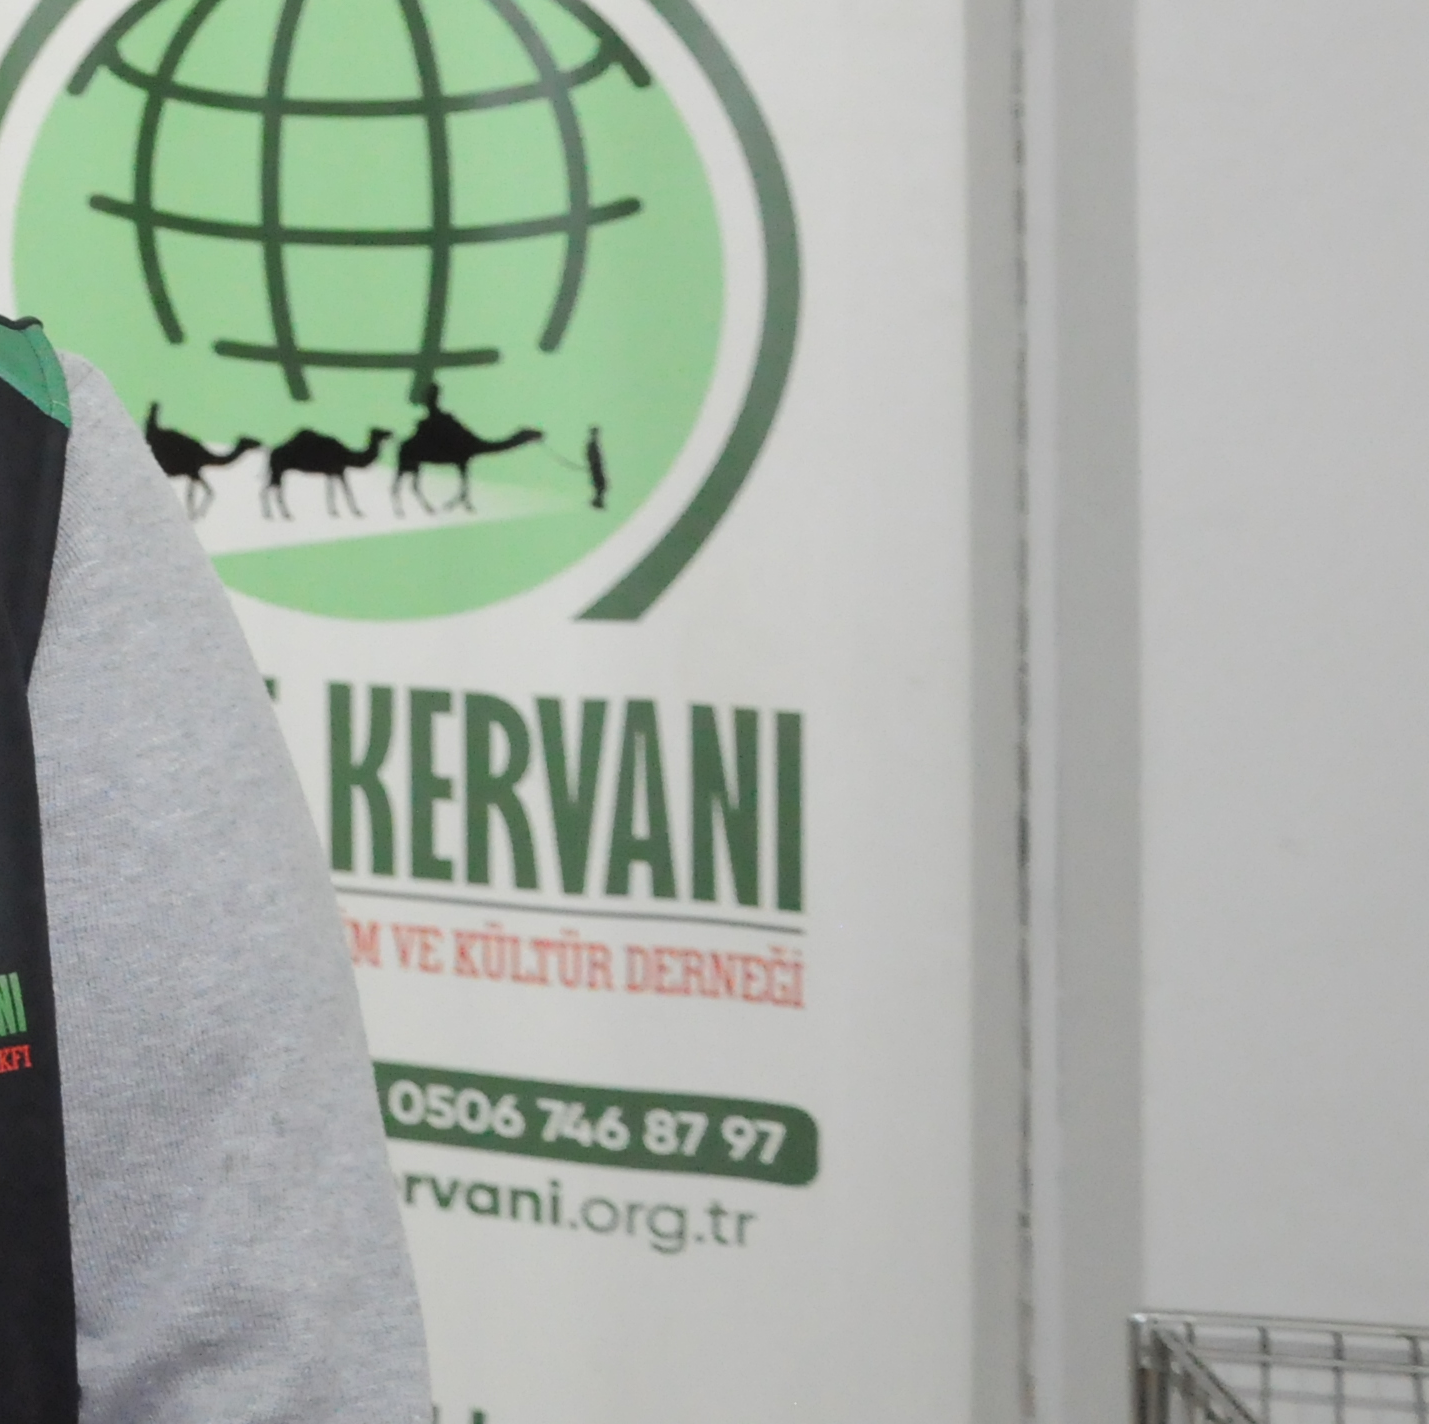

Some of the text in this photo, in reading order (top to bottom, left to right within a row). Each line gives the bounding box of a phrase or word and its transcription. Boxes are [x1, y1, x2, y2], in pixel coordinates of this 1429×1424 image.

[328, 682, 804, 912] KERVANI
[392, 922, 444, 974] VE
[453, 920, 615, 991] KÜLTÜR
[625, 945, 805, 1009] DERNEĞİ
[388, 1079, 787, 1165] 0506 746 87 97
[399, 1173, 758, 1255] rvani.org.tr
